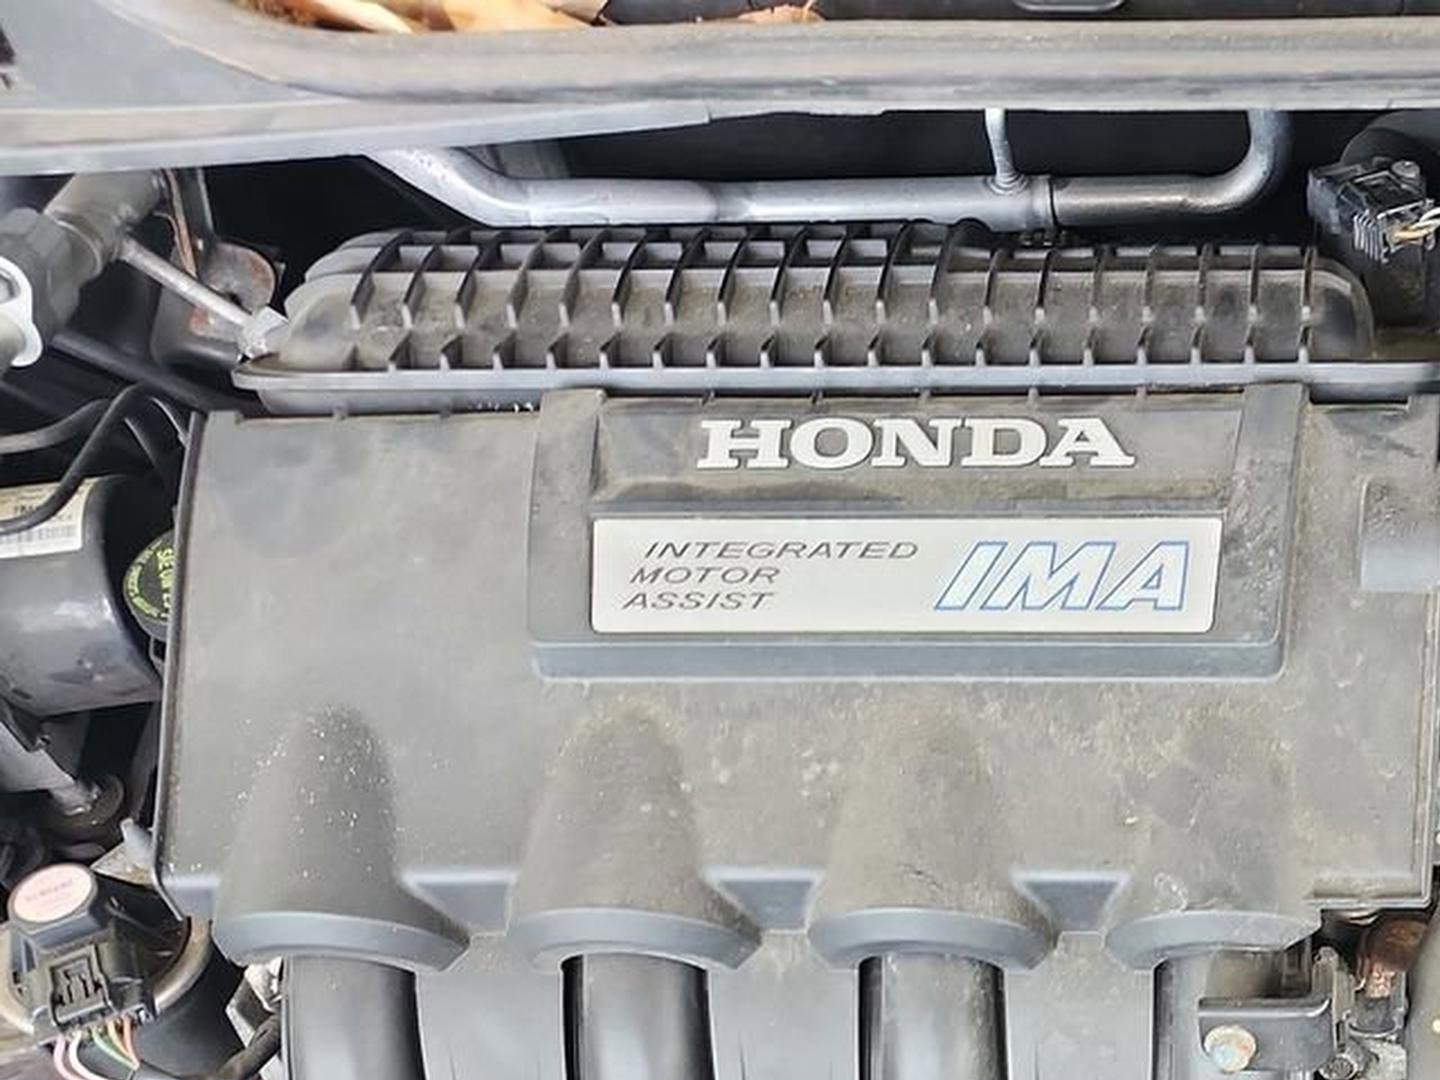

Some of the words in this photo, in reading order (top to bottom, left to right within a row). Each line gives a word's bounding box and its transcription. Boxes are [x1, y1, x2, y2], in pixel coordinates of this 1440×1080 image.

[697, 418, 1136, 469] HONDA
[643, 541, 919, 560] INTEGRATED
[629, 566, 781, 585] MOTOR
[934, 540, 1190, 611] IMA
[620, 591, 777, 611] ASSIST
